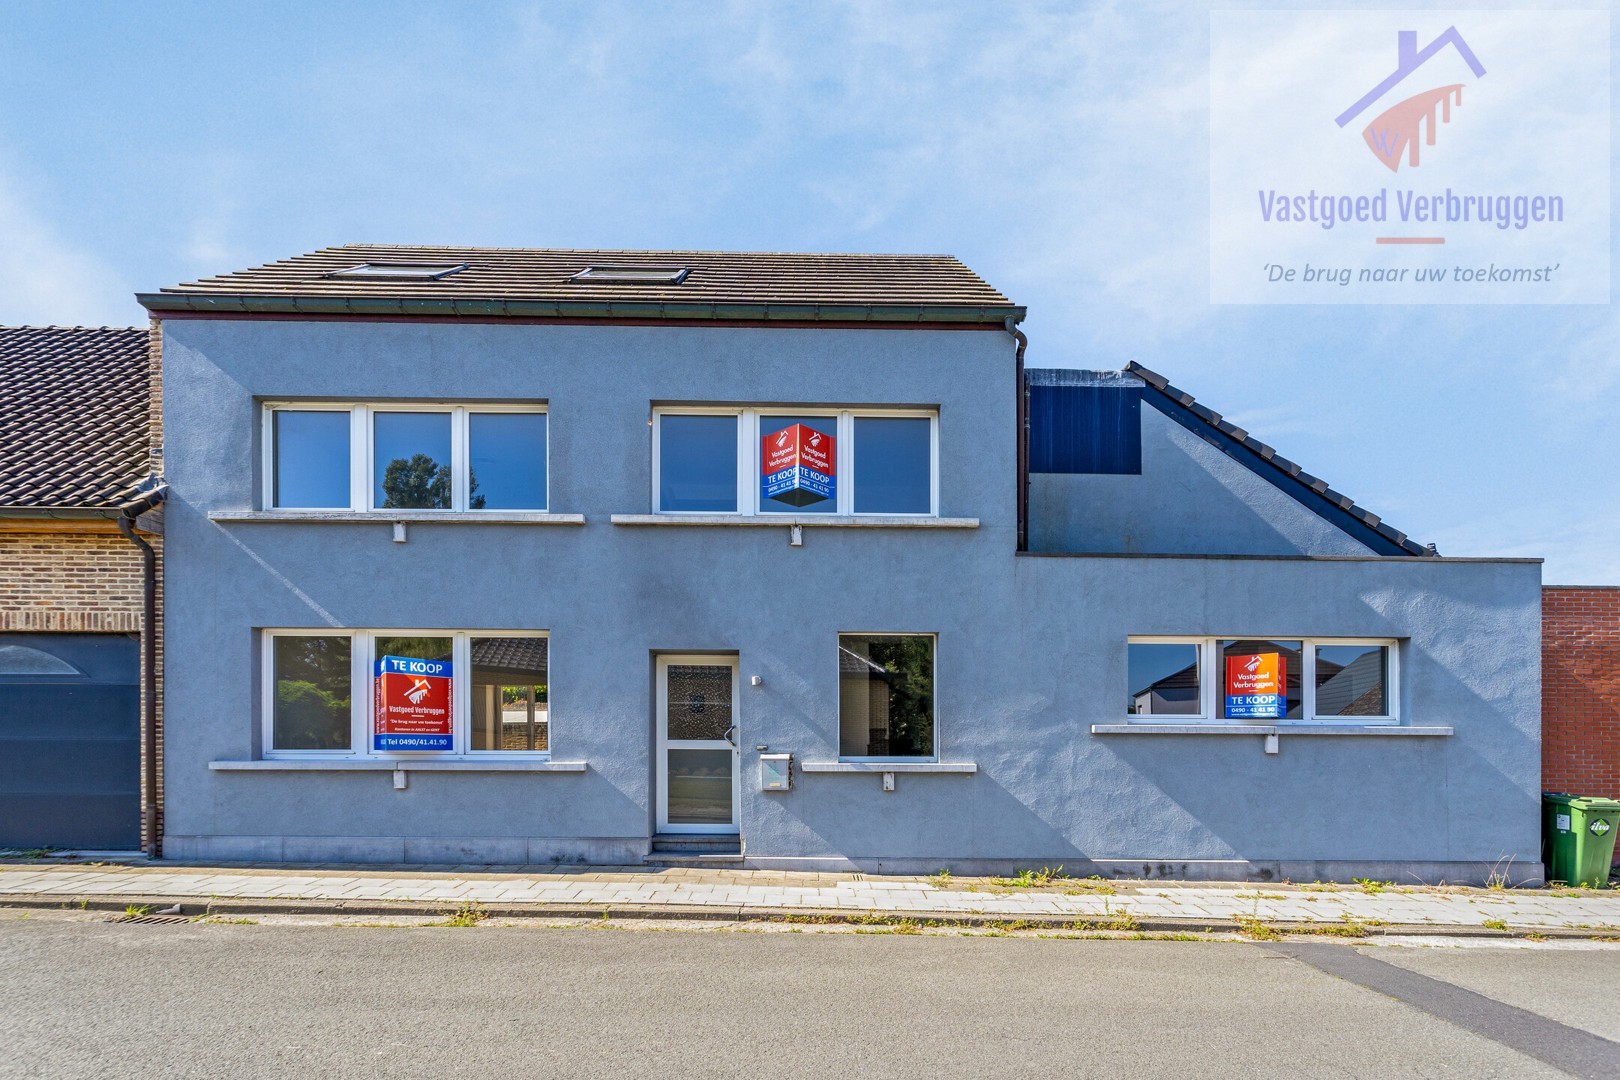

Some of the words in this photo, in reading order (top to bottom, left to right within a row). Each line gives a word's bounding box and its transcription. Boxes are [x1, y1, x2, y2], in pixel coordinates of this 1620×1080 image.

[772, 444, 794, 458] Vastgoed
[804, 445, 826, 458] Vastgoed
[768, 454, 796, 467] Verbruggen
[801, 452, 828, 468] Verbruggen
[768, 475, 776, 483] TE
[778, 468, 796, 480] KOOP
[800, 467, 808, 476] TE
[811, 471, 829, 484] KOOP
[392, 660, 406, 670] TE
[410, 662, 442, 673] KOOP
[1238, 672, 1270, 681] Vastgoed
[1246, 696, 1275, 704] KOOP
[415, 706, 444, 715] Verbruggen
